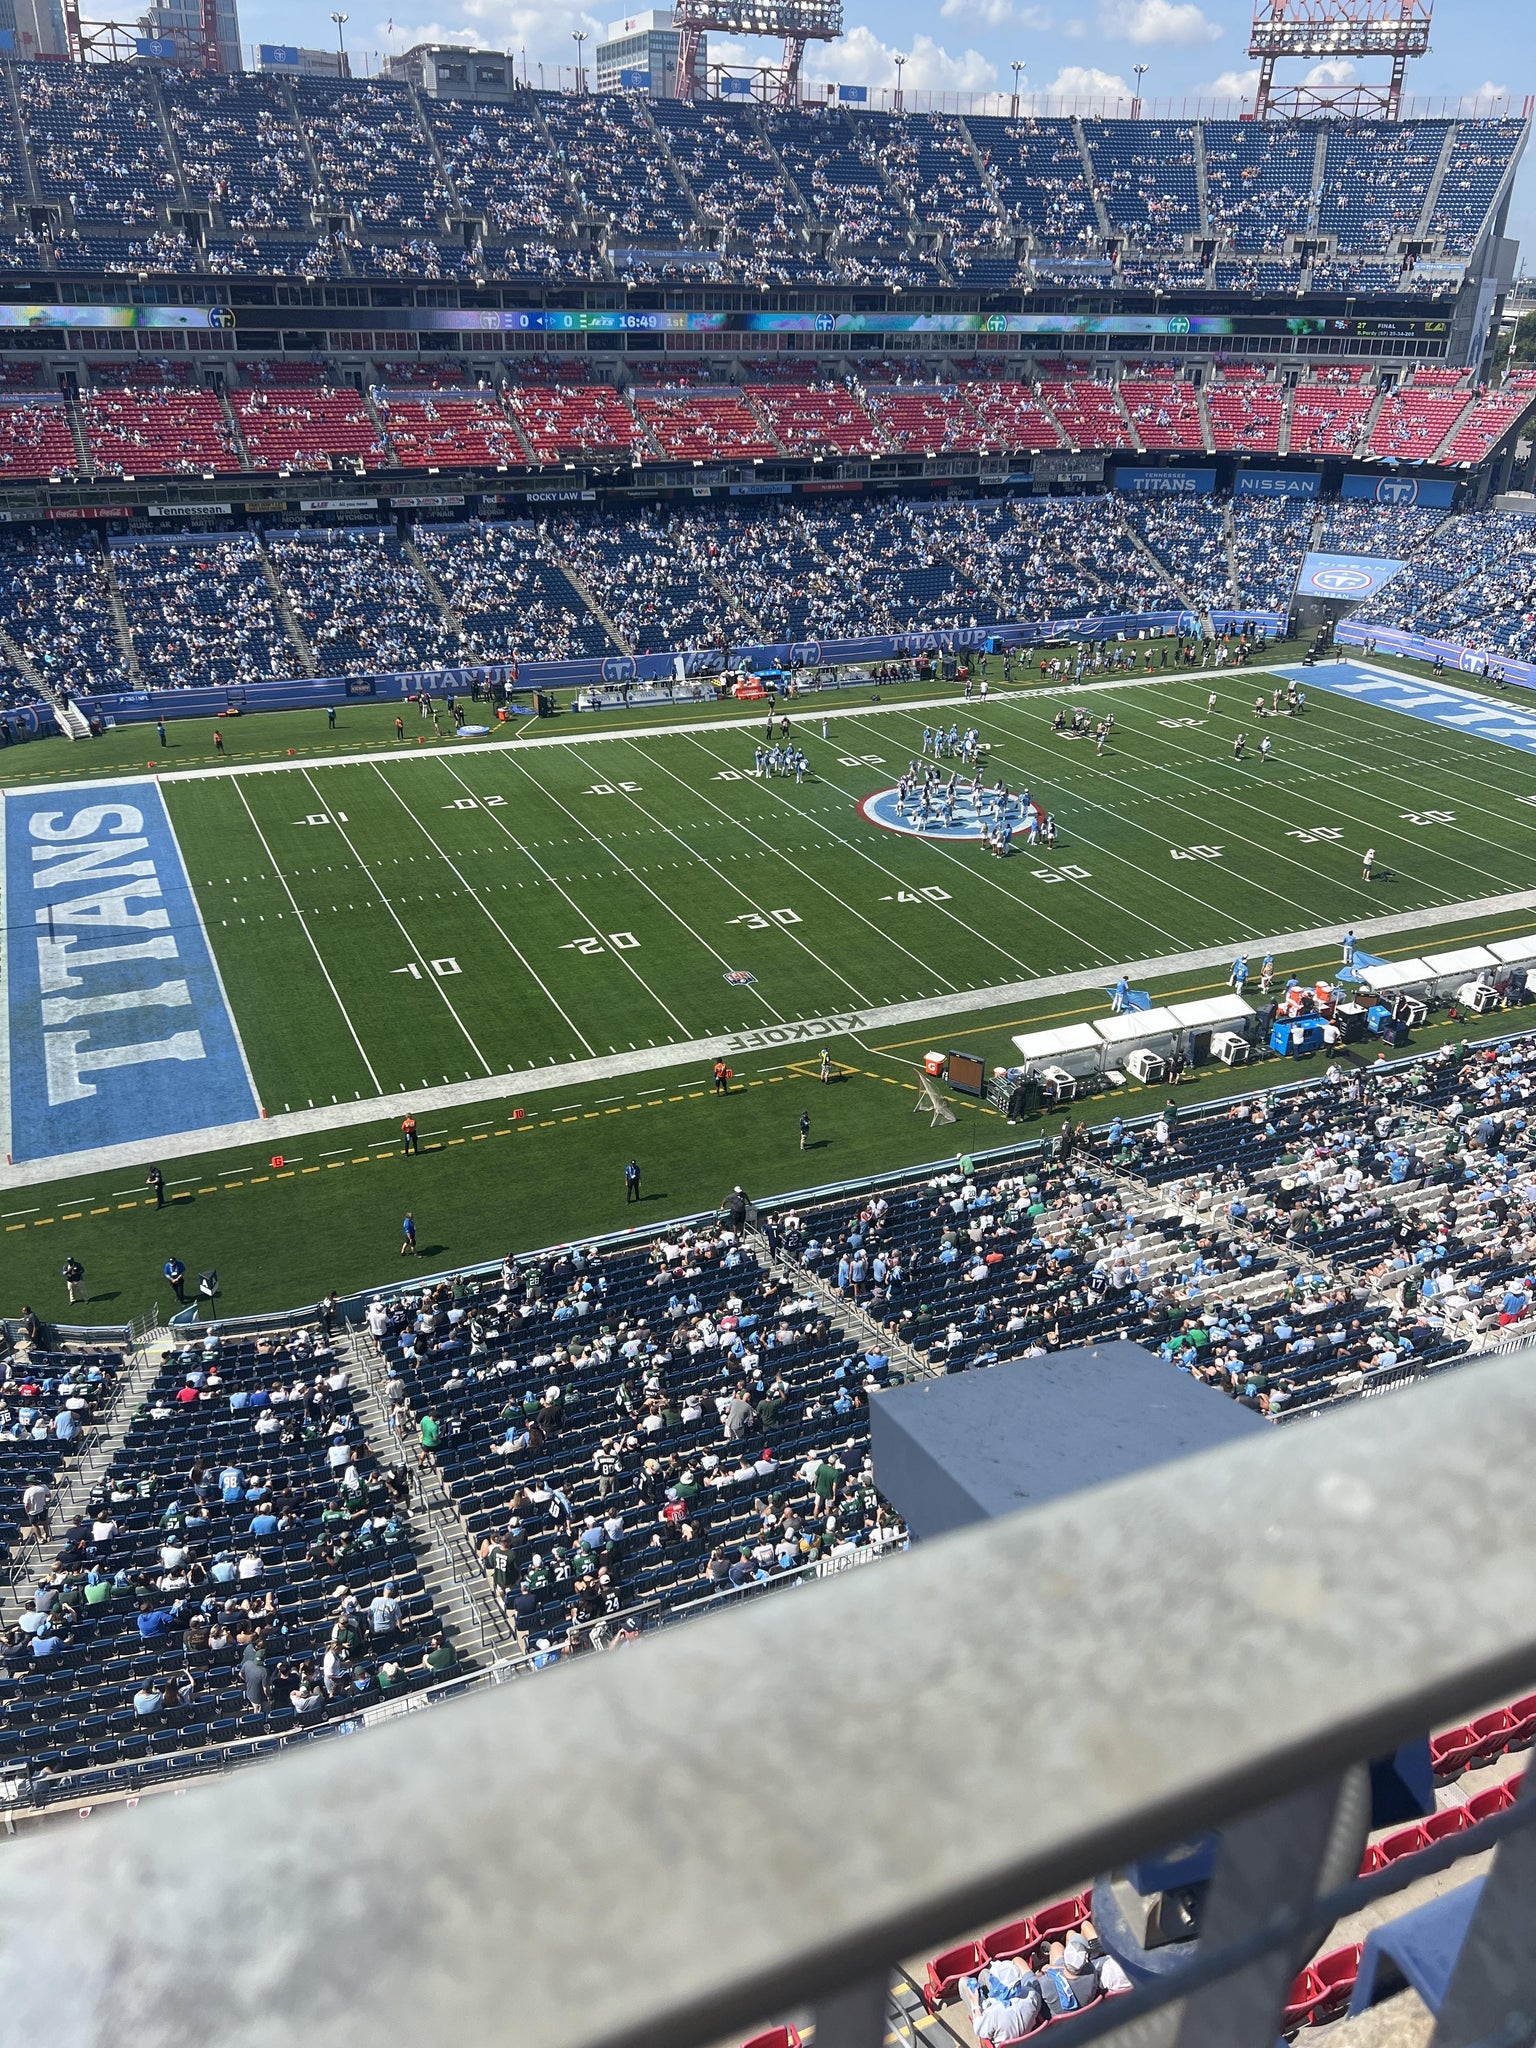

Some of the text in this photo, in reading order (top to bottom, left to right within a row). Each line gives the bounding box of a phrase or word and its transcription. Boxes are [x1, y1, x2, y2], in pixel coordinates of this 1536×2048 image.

[520, 315, 529, 327] 0
[564, 315, 573, 327] 0
[588, 316, 615, 326] JETS
[619, 316, 657, 328] 16:49
[666, 317, 684, 327] 1st
[750, 485, 784, 494] Gallagher
[1133, 478, 1196, 491] TITANS
[1241, 478, 1315, 492] NISSAN
[482, 495, 507, 504] FedEx
[526, 492, 578, 502] ROCKY LAW
[55, 509, 79, 519] Coca-Cola
[99, 508, 122, 518] Coca-Cola
[156, 505, 227, 516] Tennessean.
[479, 509, 506, 517] GEORGE
[281, 516, 307, 524] MOON
[336, 513, 375, 522] WYCHECK
[1318, 561, 1387, 572] NISSAN
[1313, 591, 1350, 600] NISSAN
[889, 629, 987, 651] TITAN UP
[394, 670, 478, 692] TITAN
[836, 754, 887, 767] 50
[590, 781, 644, 796] 30
[453, 794, 509, 810] 20
[305, 811, 349, 826] 10
[1398, 810, 1457, 826] 20
[1284, 826, 1345, 844] 30
[1169, 844, 1224, 861] 40
[1029, 864, 1093, 884] 50
[897, 885, 953, 904] 40
[737, 907, 804, 930] 30
[572, 931, 642, 955] 20
[28, 803, 207, 1108] TITANS
[407, 957, 463, 980] 10
[726, 1014, 868, 1052] KICKOFF
[927, 1062, 936, 1072] G
[514, 1109, 524, 1118] 10
[1453, 1135, 1459, 1143] 2
[274, 1157, 282, 1166] G
[788, 1235, 800, 1247] 22
[202, 1278, 209, 1288] A
[1091, 1279, 1103, 1290] 17
[602, 1463, 614, 1475] 80
[223, 1476, 239, 1489] 98
[864, 1495, 877, 1508] 24
[495, 1557, 507, 1572] 12
[582, 1563, 595, 1575] 20
[554, 1565, 572, 1582] 20
[605, 1597, 620, 1613] 24
